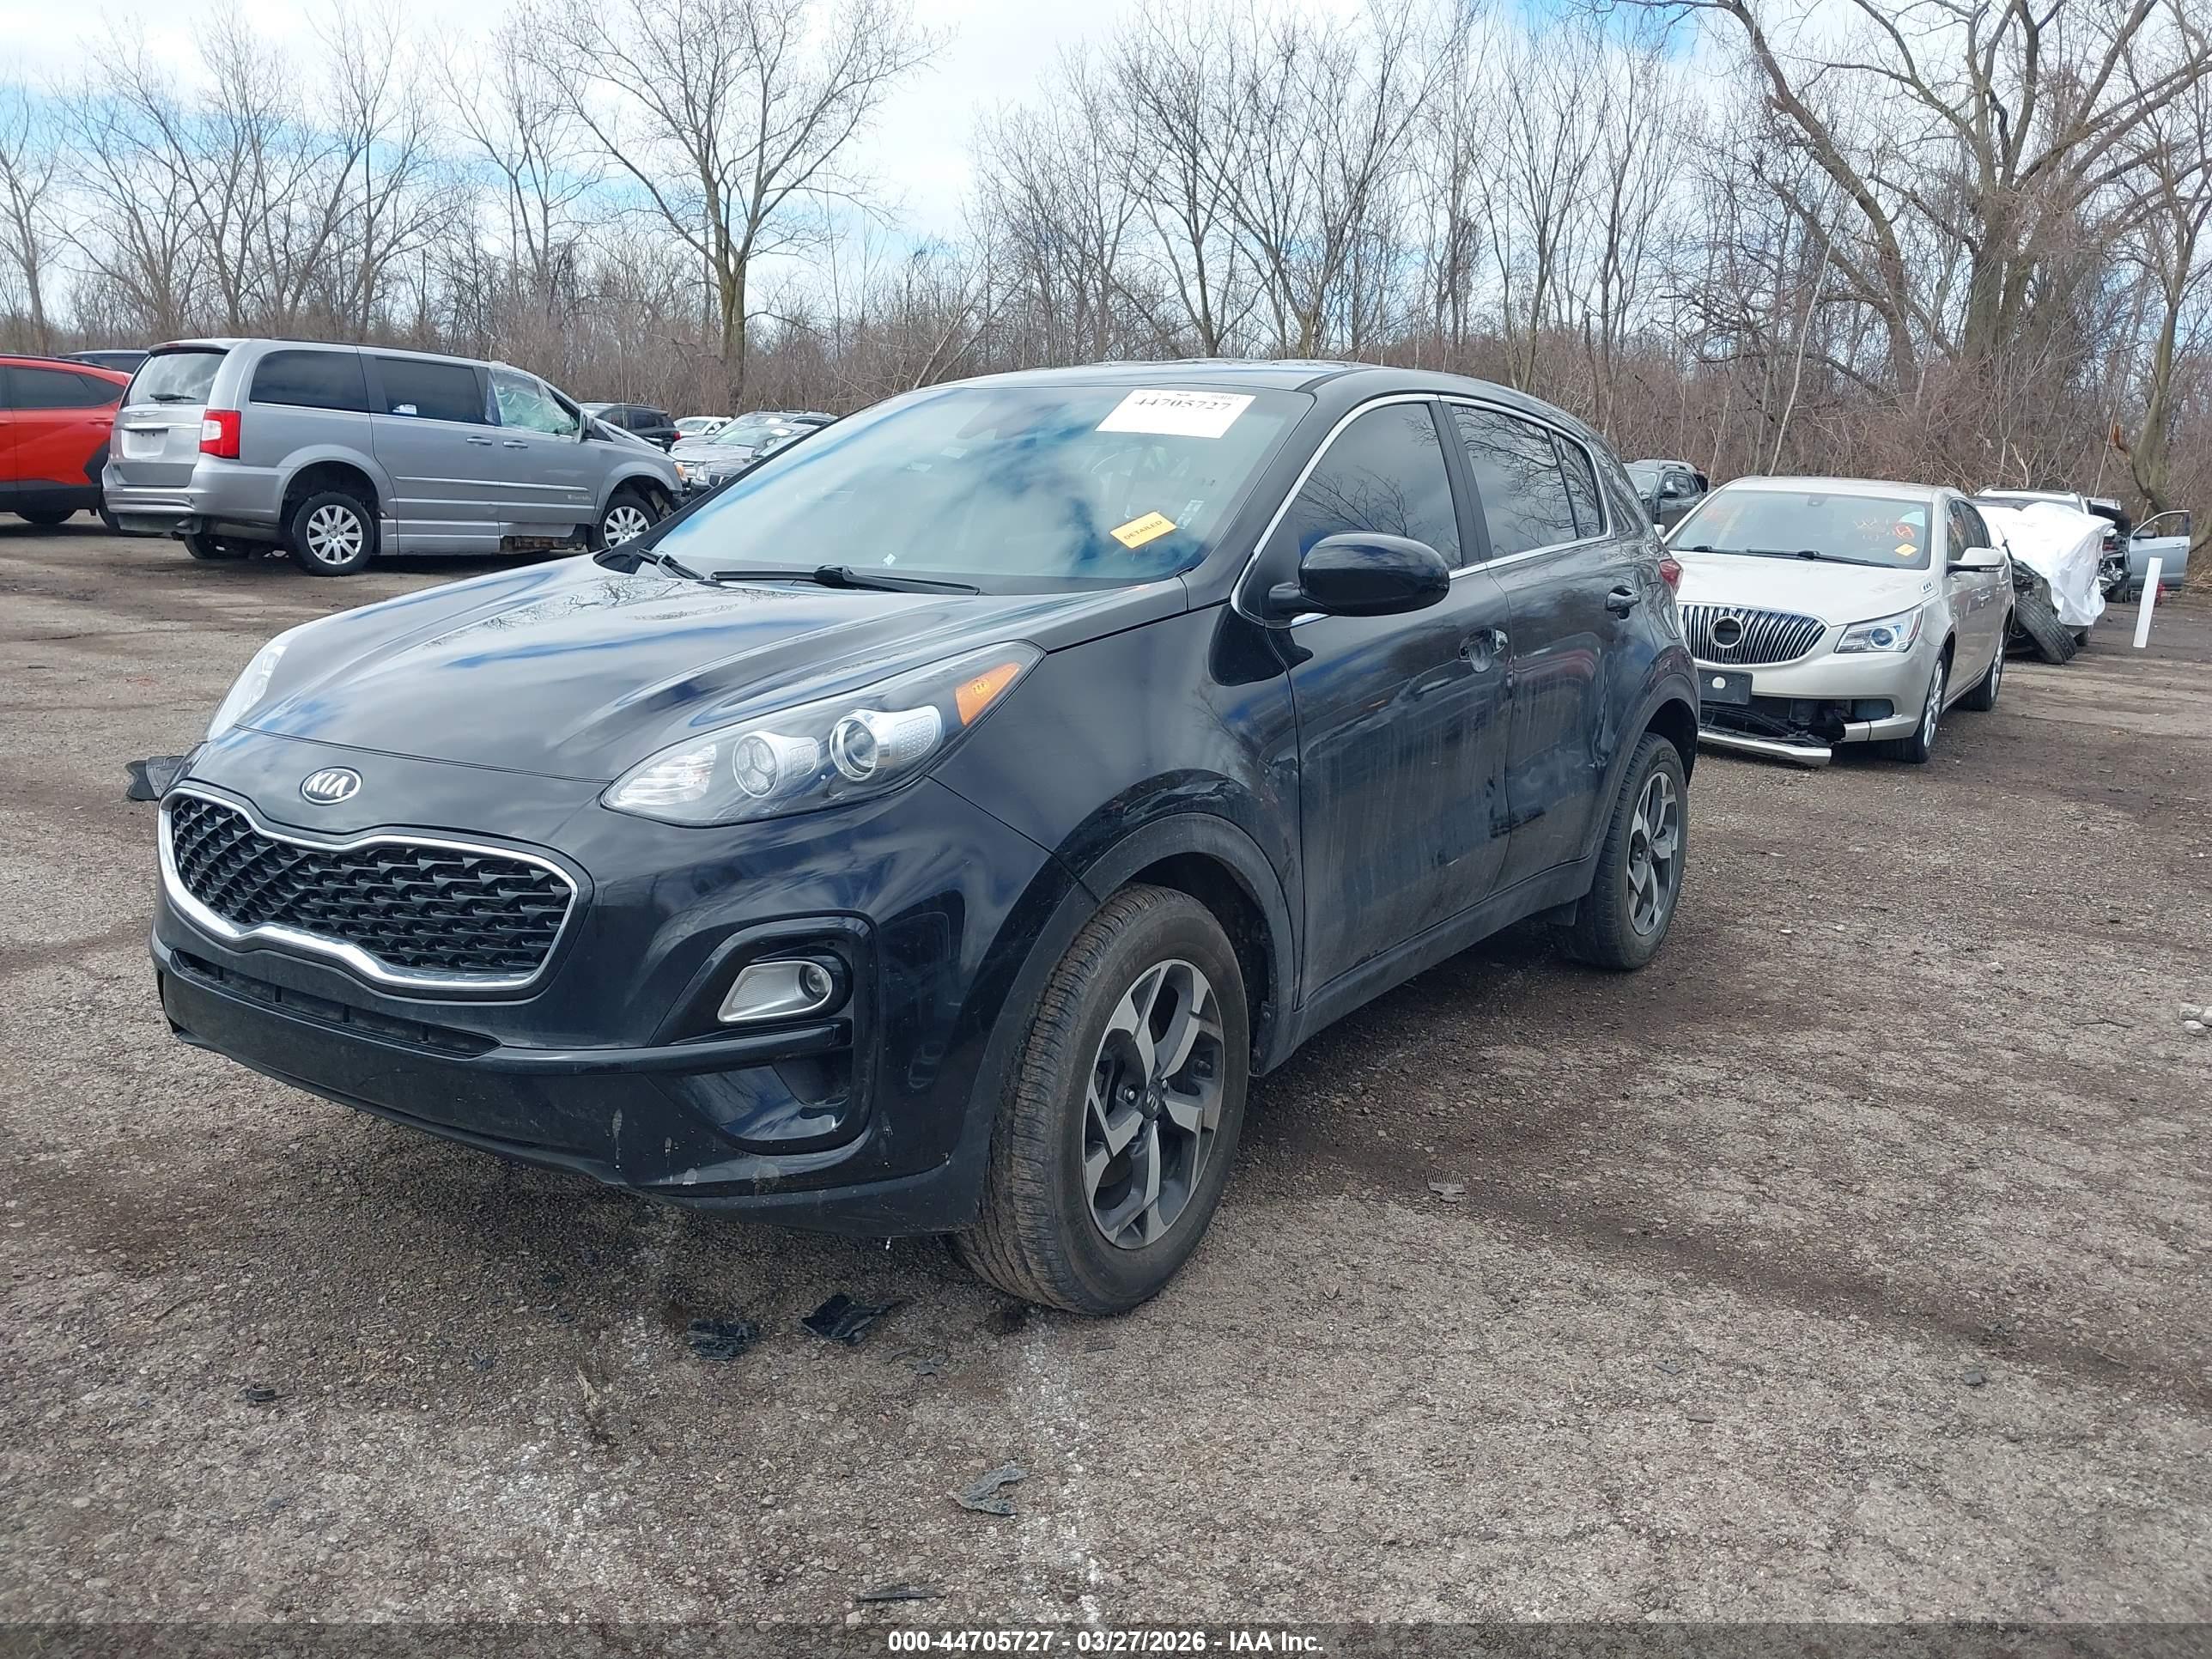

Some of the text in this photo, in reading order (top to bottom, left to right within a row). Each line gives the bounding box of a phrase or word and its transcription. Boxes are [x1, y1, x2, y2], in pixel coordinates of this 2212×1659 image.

[1123, 520, 1163, 540] DETAILED
[306, 772, 349, 798] KIA
[1146, 1091, 1159, 1112] KIA
